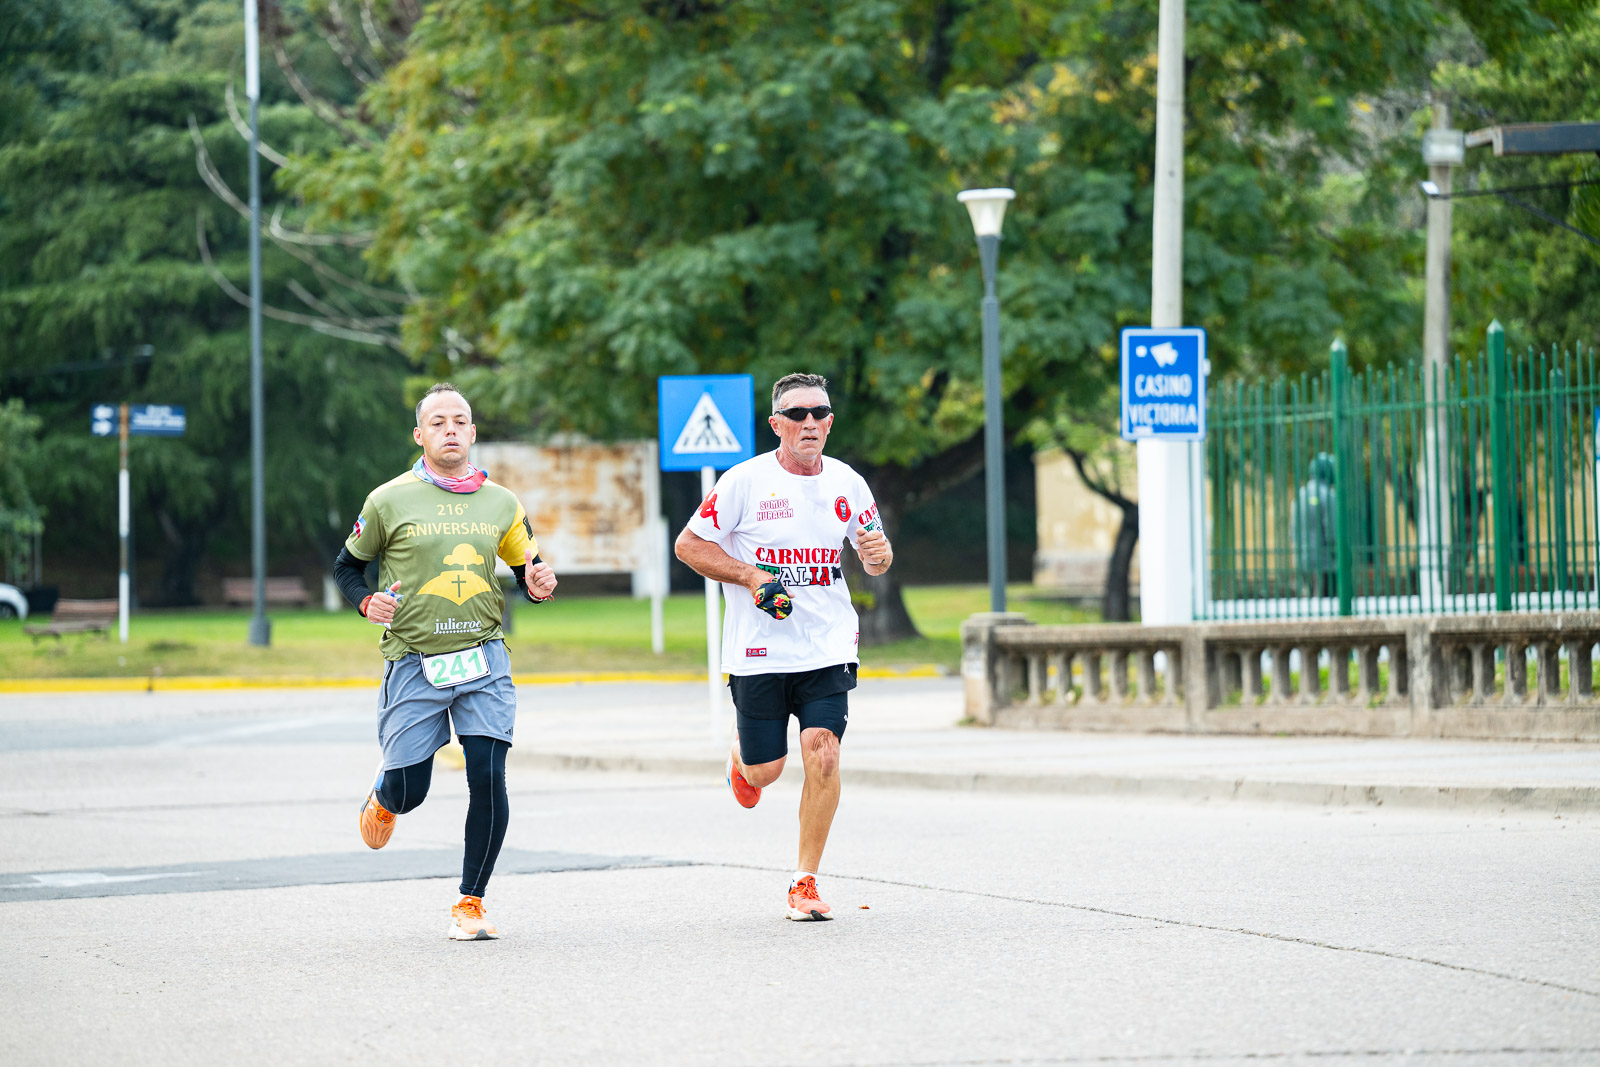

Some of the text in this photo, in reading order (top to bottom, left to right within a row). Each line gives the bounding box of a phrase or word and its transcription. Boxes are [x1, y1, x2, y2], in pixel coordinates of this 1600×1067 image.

[1135, 373, 1192, 398] CASINO
[1128, 402, 1198, 427] VICTORIA
[436, 503, 469, 516] 216°
[759, 498, 790, 511] SOMOS
[406, 522, 500, 538] ANIVERSARIO
[430, 651, 483, 684] 241
